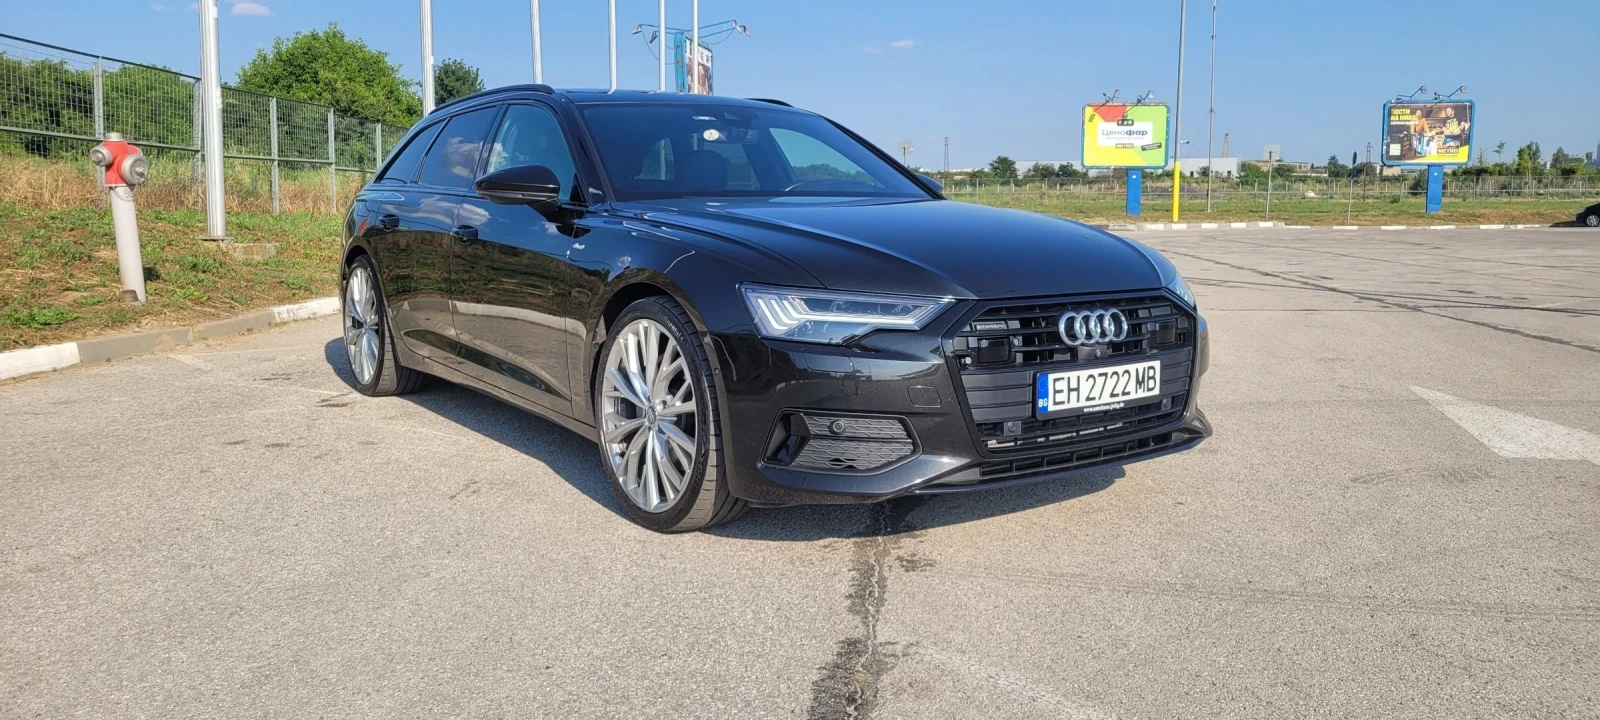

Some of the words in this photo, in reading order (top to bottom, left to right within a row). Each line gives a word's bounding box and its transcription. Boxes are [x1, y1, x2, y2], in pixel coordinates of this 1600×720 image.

[1101, 129, 1148, 137] Ценофар
[656, 311, 682, 339] ntinental
[1053, 375, 1081, 406] EH
[1085, 369, 1131, 402] 2722
[1135, 366, 1157, 394] MB
[1038, 399, 1048, 408] BG
